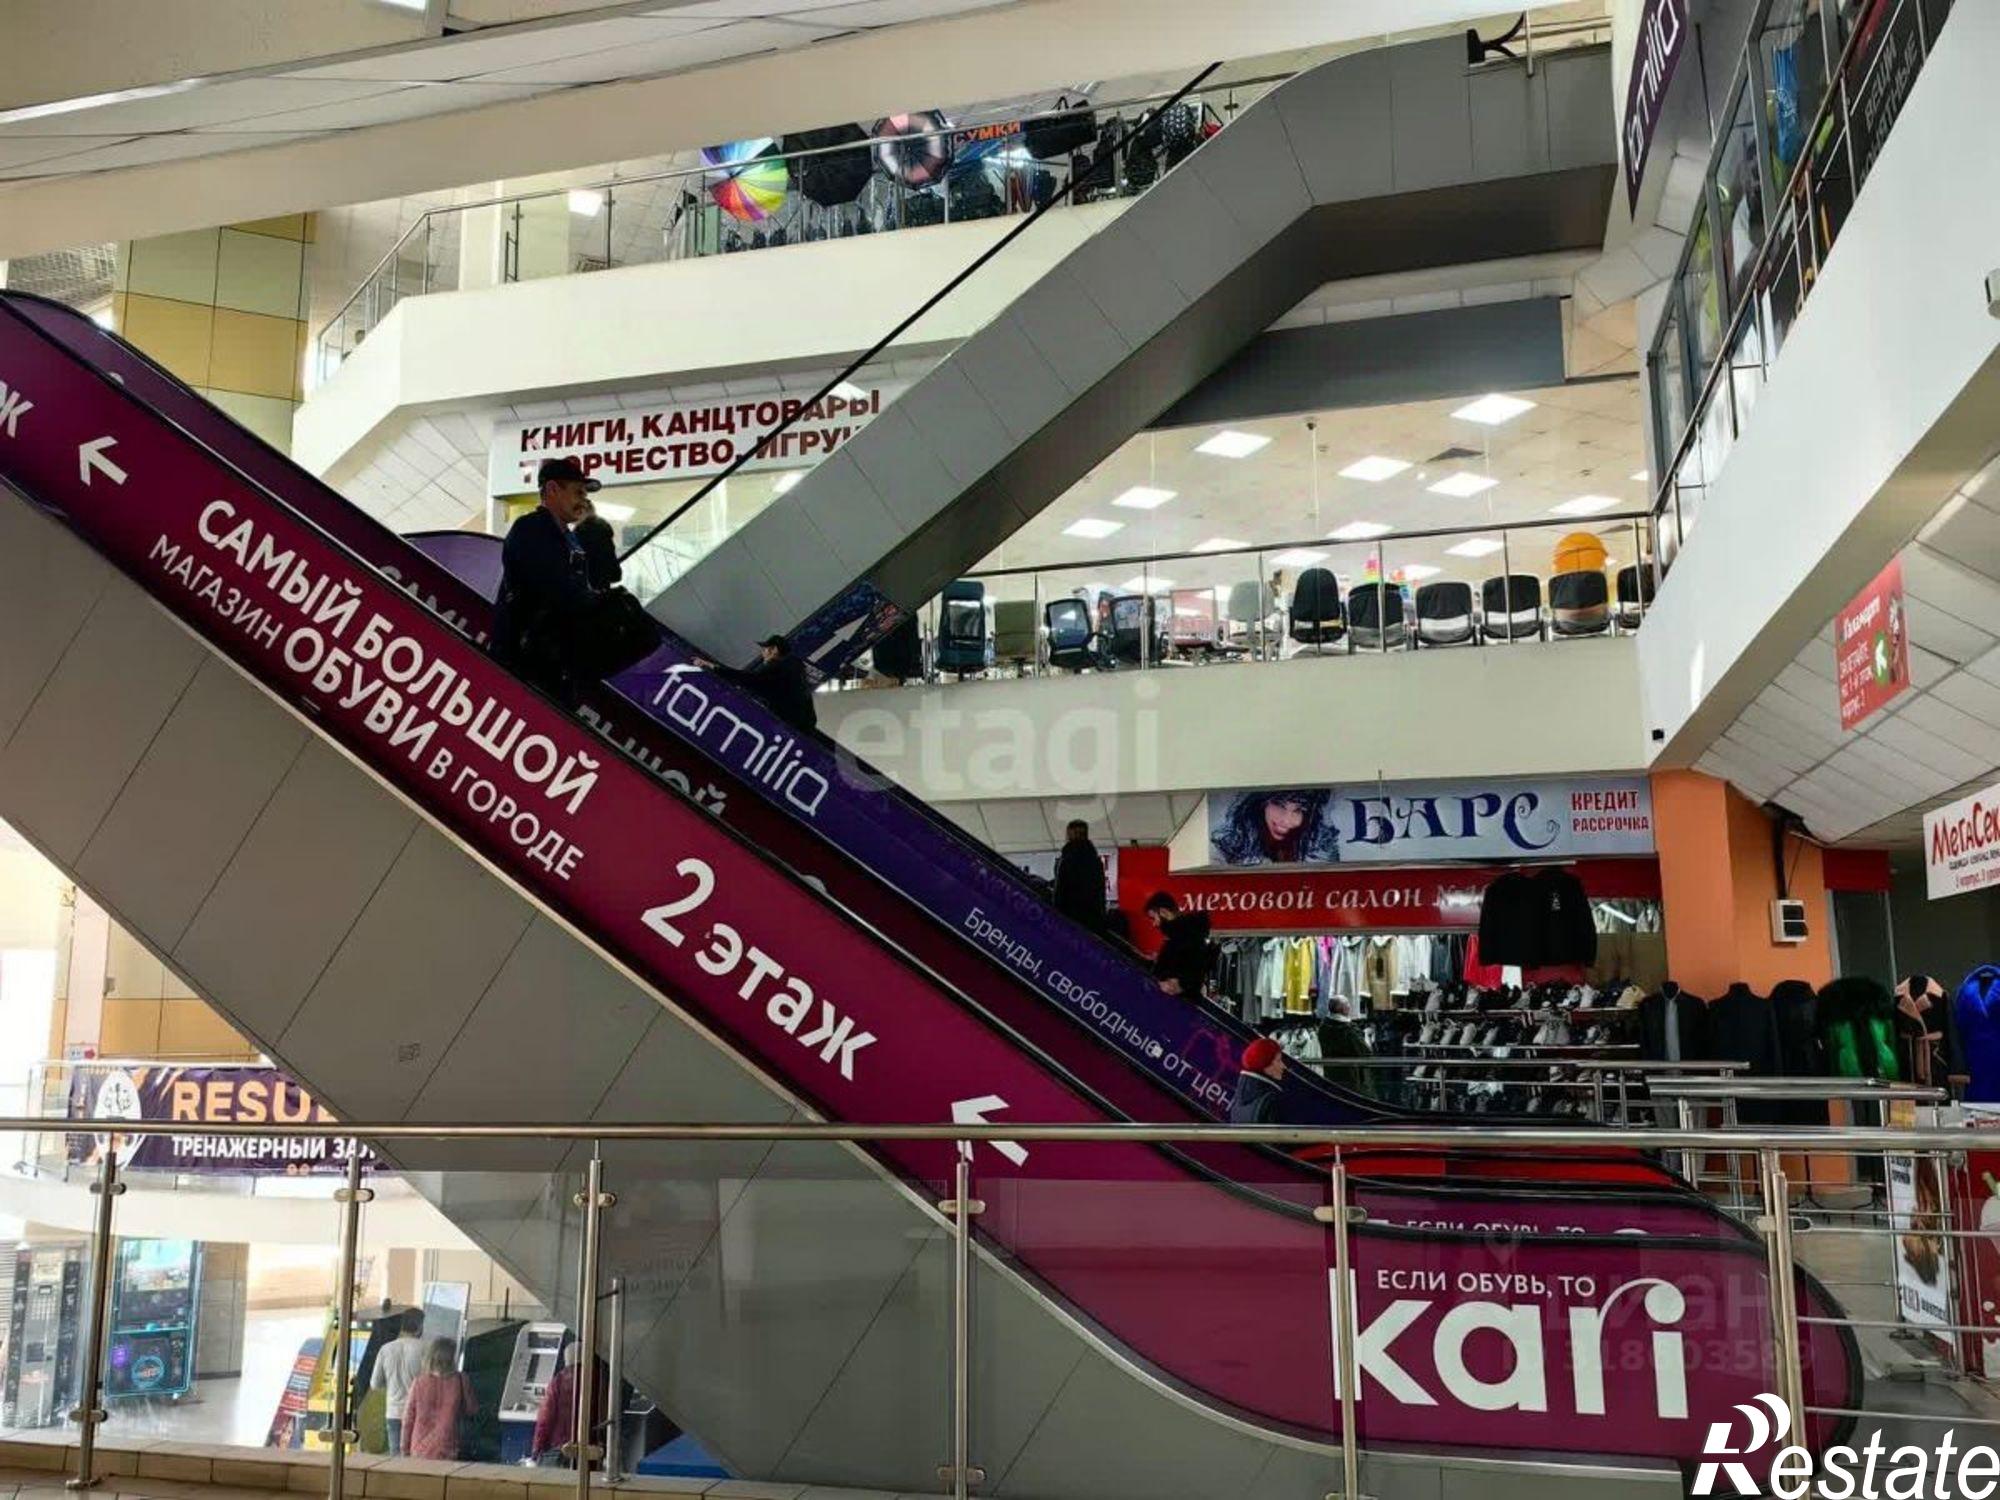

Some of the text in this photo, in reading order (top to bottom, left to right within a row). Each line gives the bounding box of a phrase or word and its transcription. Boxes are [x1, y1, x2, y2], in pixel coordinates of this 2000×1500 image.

[521, 389, 880, 453] КНИГИ, КАНЦТОВАРЫ
[148, 534, 285, 650] МАГАЗИН
[284, 627, 440, 763] ОБУВИ
[426, 747, 454, 780] В
[450, 766, 585, 881] ГОРОДЕ
[198, 500, 363, 638] САМЫЙ
[352, 613, 600, 815] БОЛЬШОЙ
[662, 663, 830, 817] familia
[1345, 792, 1561, 851] БАРС
[1572, 791, 1638, 812] КРЕДИТ
[1572, 816, 1649, 832] РАССРОЧКА
[1179, 884, 1314, 913] меховой
[1325, 887, 1422, 910] салон
[640, 857, 878, 1082] 2 этаж
[963, 907, 1042, 979] Бренды,
[1047, 970, 1162, 1059] свободные
[1162, 1052, 1193, 1078] от
[1377, 1269, 1597, 1298] ЕСЛИ ОБУВЬ, ТО
[1328, 1268, 1689, 1420] kari
